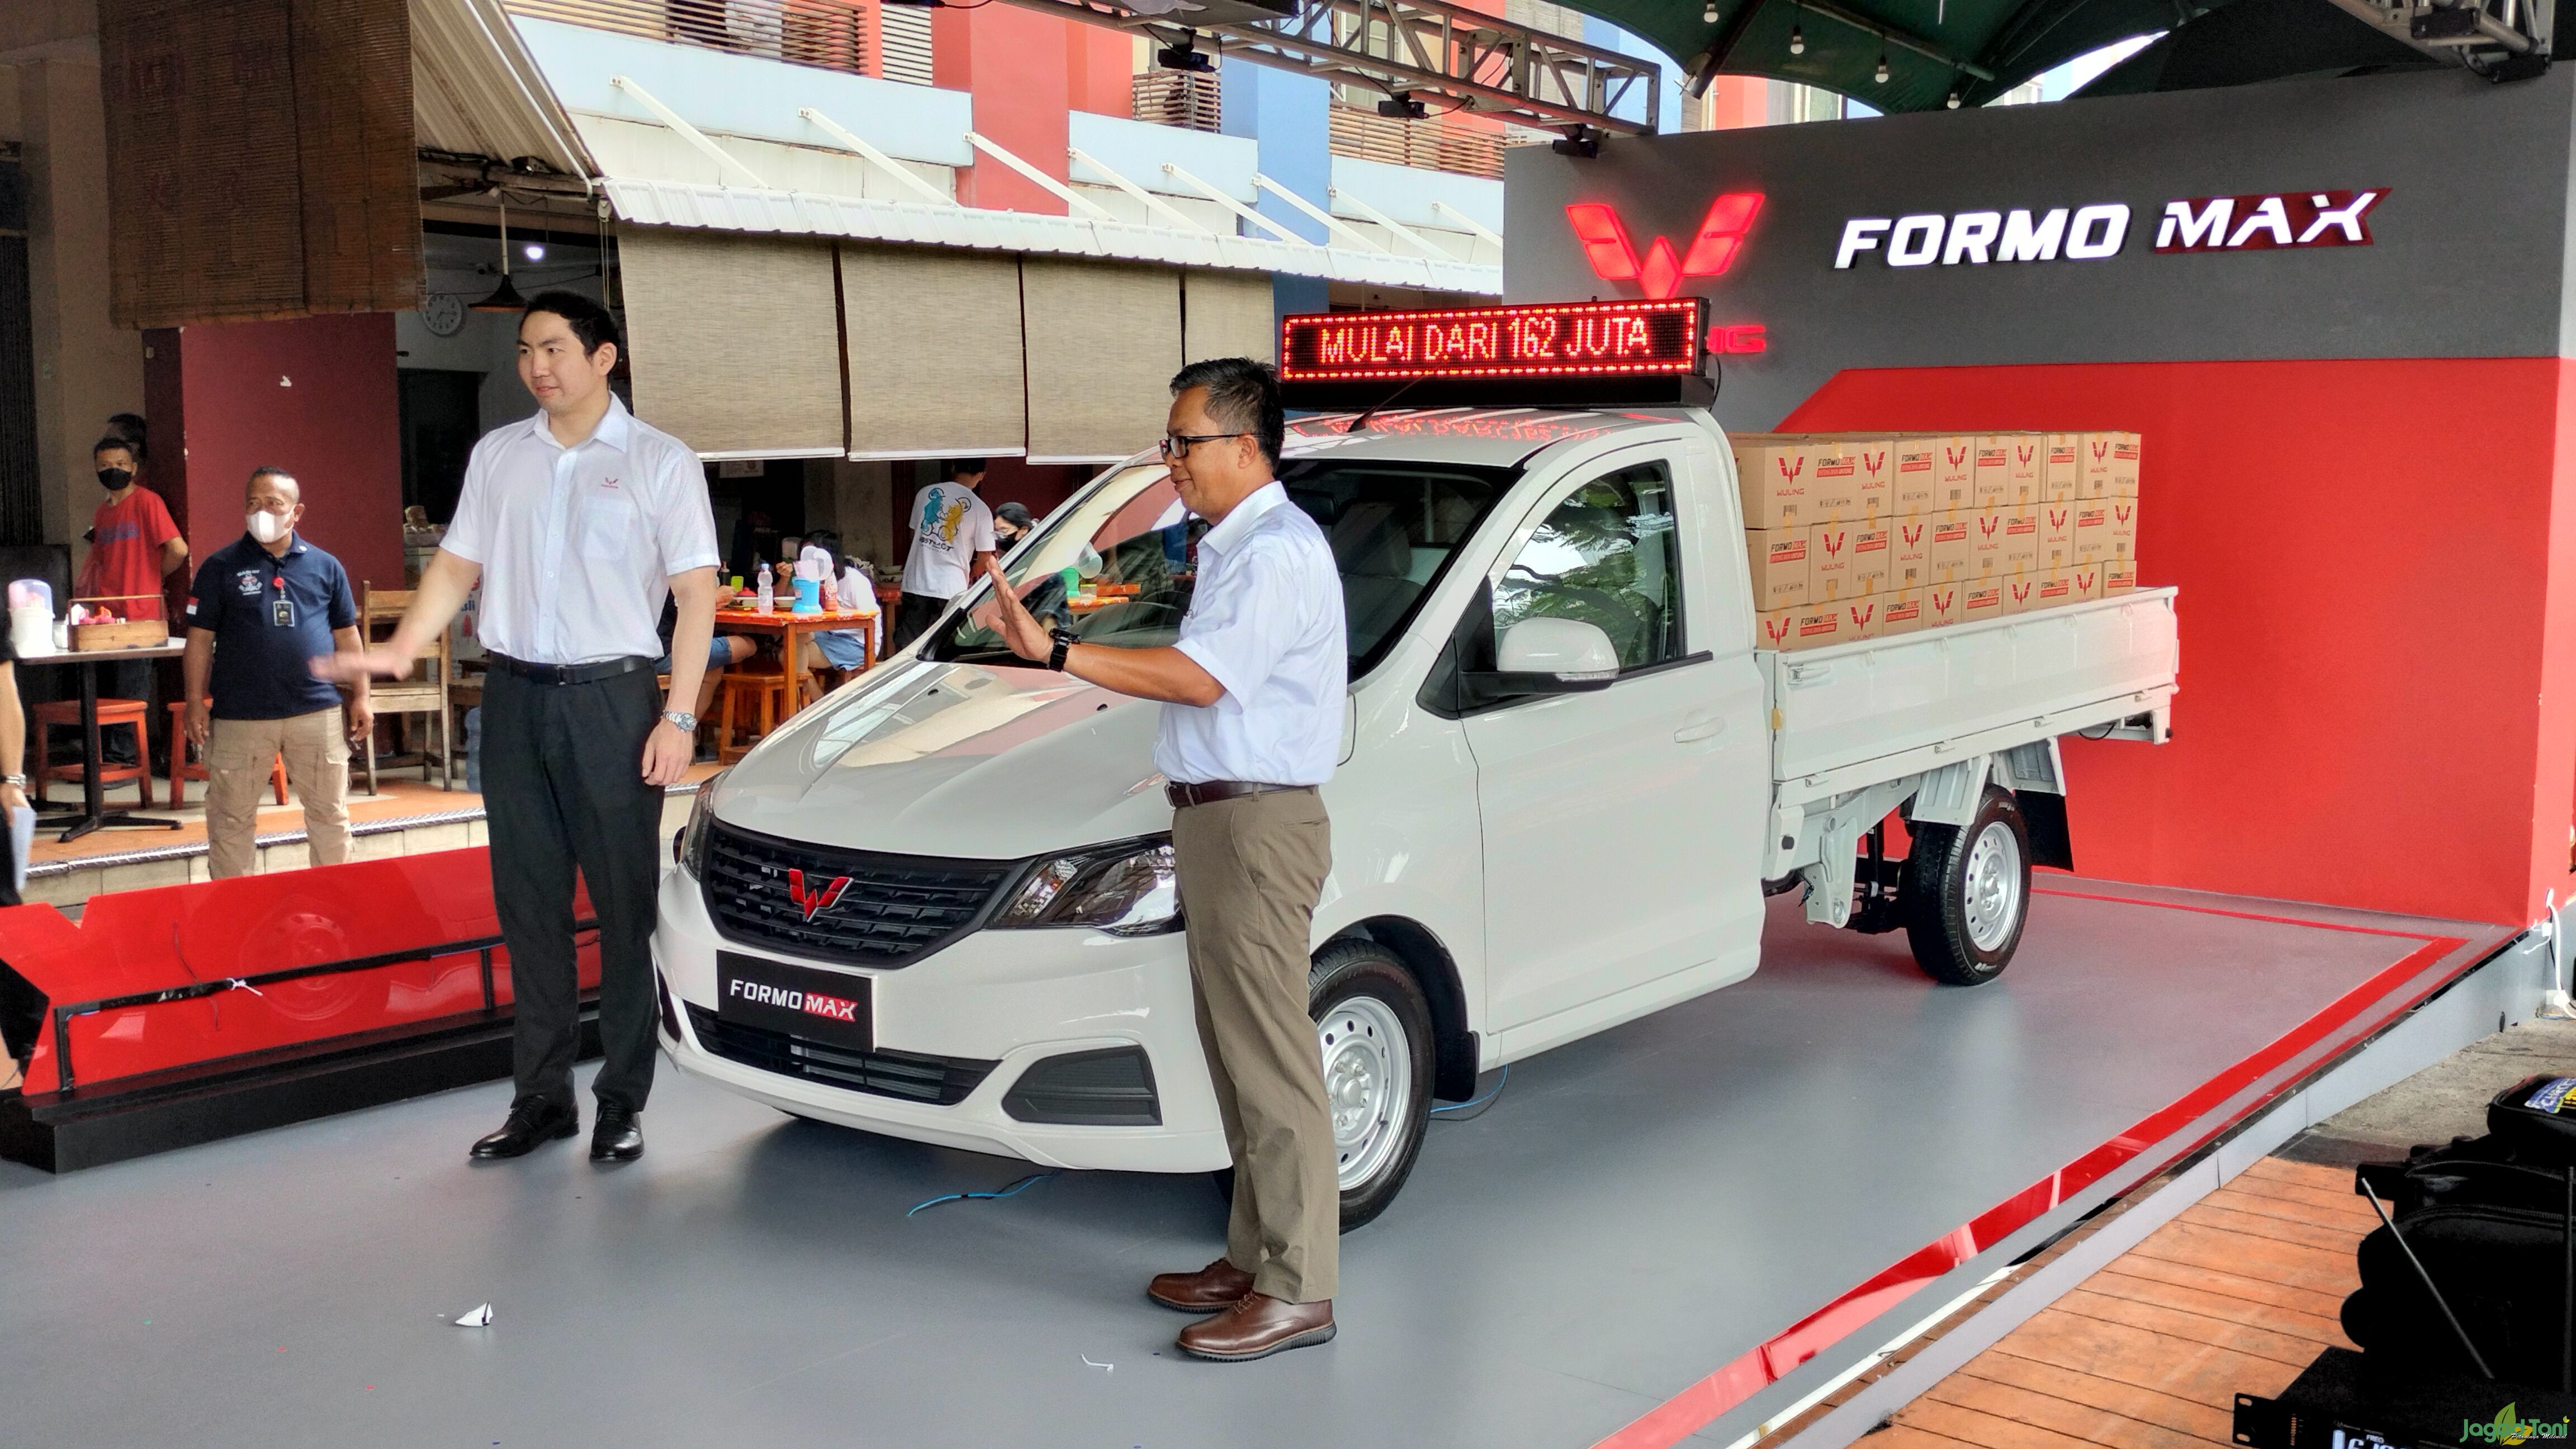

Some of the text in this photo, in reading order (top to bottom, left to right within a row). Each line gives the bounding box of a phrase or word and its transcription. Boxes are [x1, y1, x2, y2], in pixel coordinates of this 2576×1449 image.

[1834, 193, 2377, 269] FORMO MAX
[1320, 316, 1650, 363] MULAI DARI 162 JUTA
[1821, 562, 1844, 571] WULING
[1801, 615, 1823, 624] FORMO
[730, 979, 858, 1020] FORMO MAX
